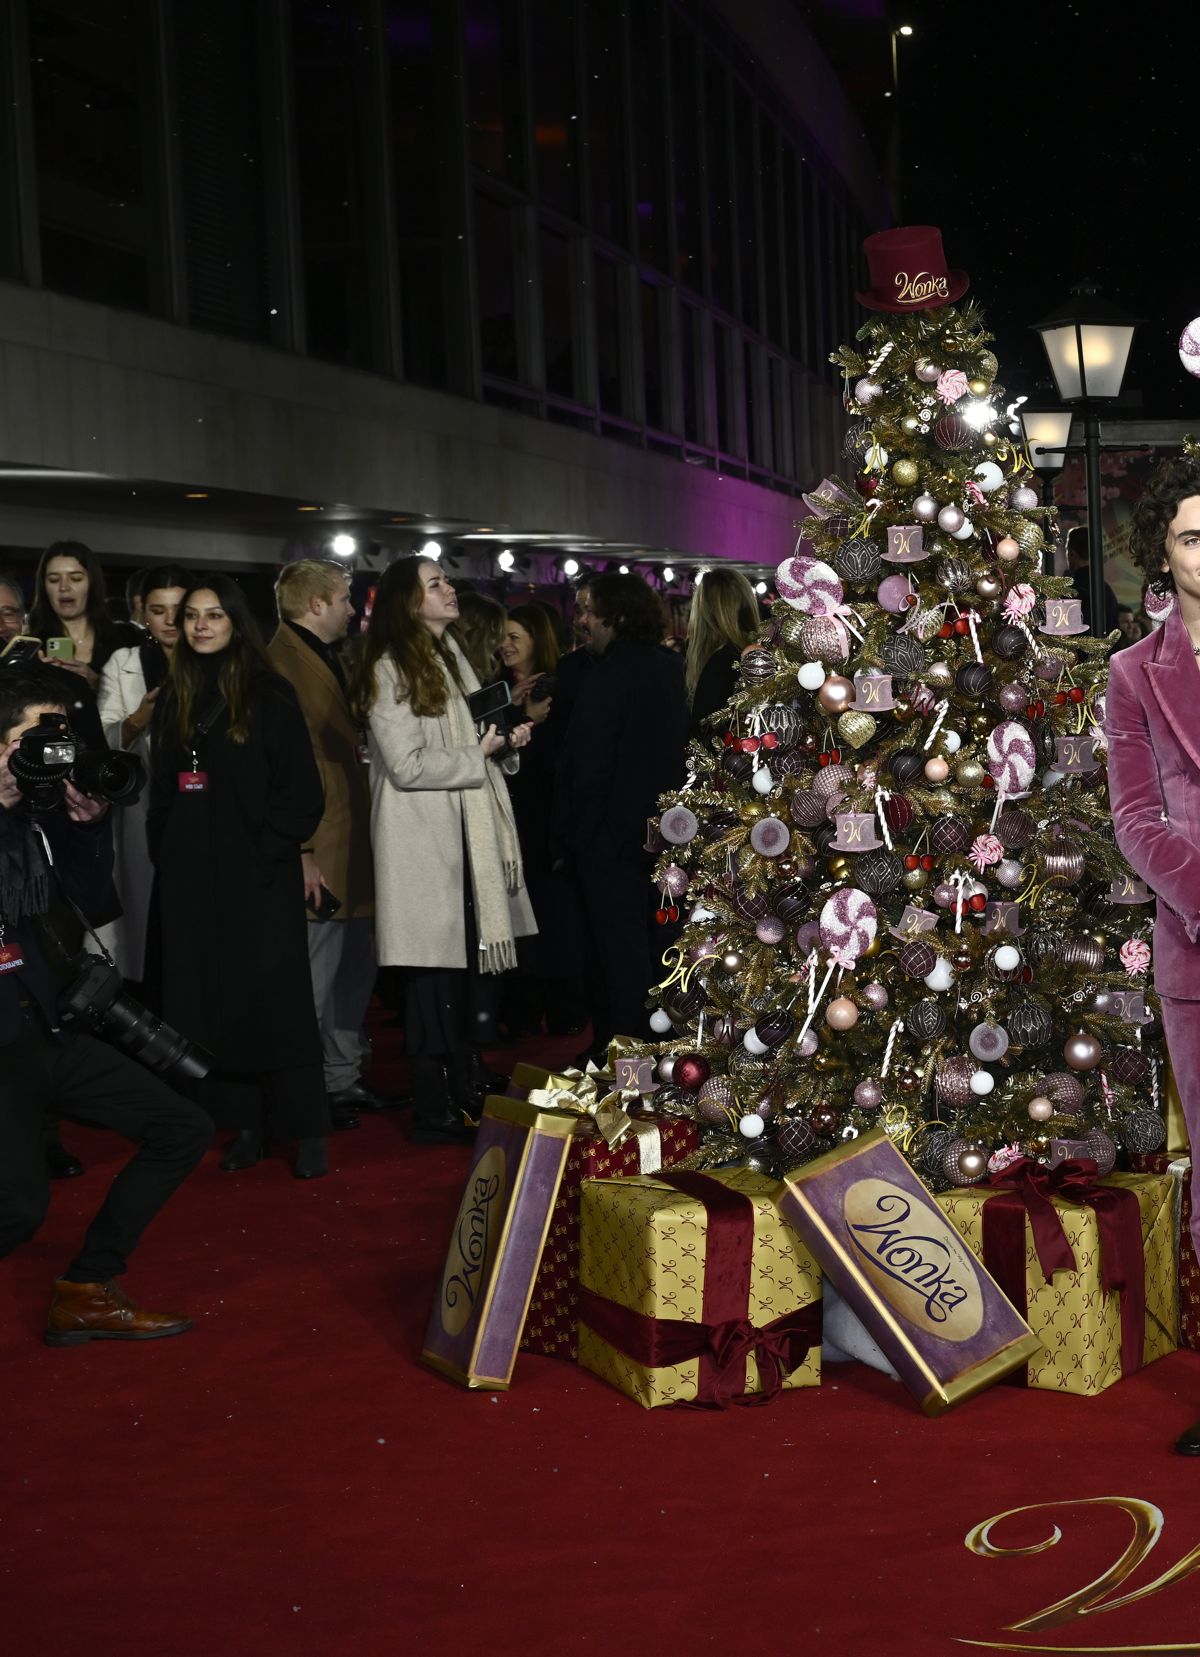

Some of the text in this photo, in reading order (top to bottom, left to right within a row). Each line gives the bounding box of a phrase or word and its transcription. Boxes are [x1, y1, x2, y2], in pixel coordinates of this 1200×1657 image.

[894, 271, 949, 303] Wonka
[893, 530, 917, 555] W
[1052, 605, 1076, 628] W
[861, 680, 887, 704] W
[1063, 741, 1088, 765] W
[843, 821, 868, 844] W
[1014, 864, 1069, 909] W
[993, 907, 1012, 930] W
[659, 946, 723, 993] W
[1114, 995, 1140, 1018] W
[622, 1063, 651, 1086] W
[446, 1173, 500, 1308] Wonka
[1068, 1230, 1086, 1247] W
[845, 1194, 968, 1323] Wonka
[1083, 1249, 1096, 1267] W
[1069, 1271, 1085, 1288] W
[1028, 1288, 1043, 1302] W
[1055, 1291, 1071, 1306] W
[1082, 1289, 1099, 1309] W
[1044, 1310, 1059, 1325] W
[1070, 1313, 1087, 1328] W
[1056, 1331, 1071, 1346] W
[1084, 1331, 1098, 1349] W
[1045, 1350, 1061, 1365] W
[1072, 1354, 1087, 1368] W
[1029, 1368, 1044, 1382] W
[1057, 1372, 1073, 1387] W
[1084, 1371, 1100, 1389] W
